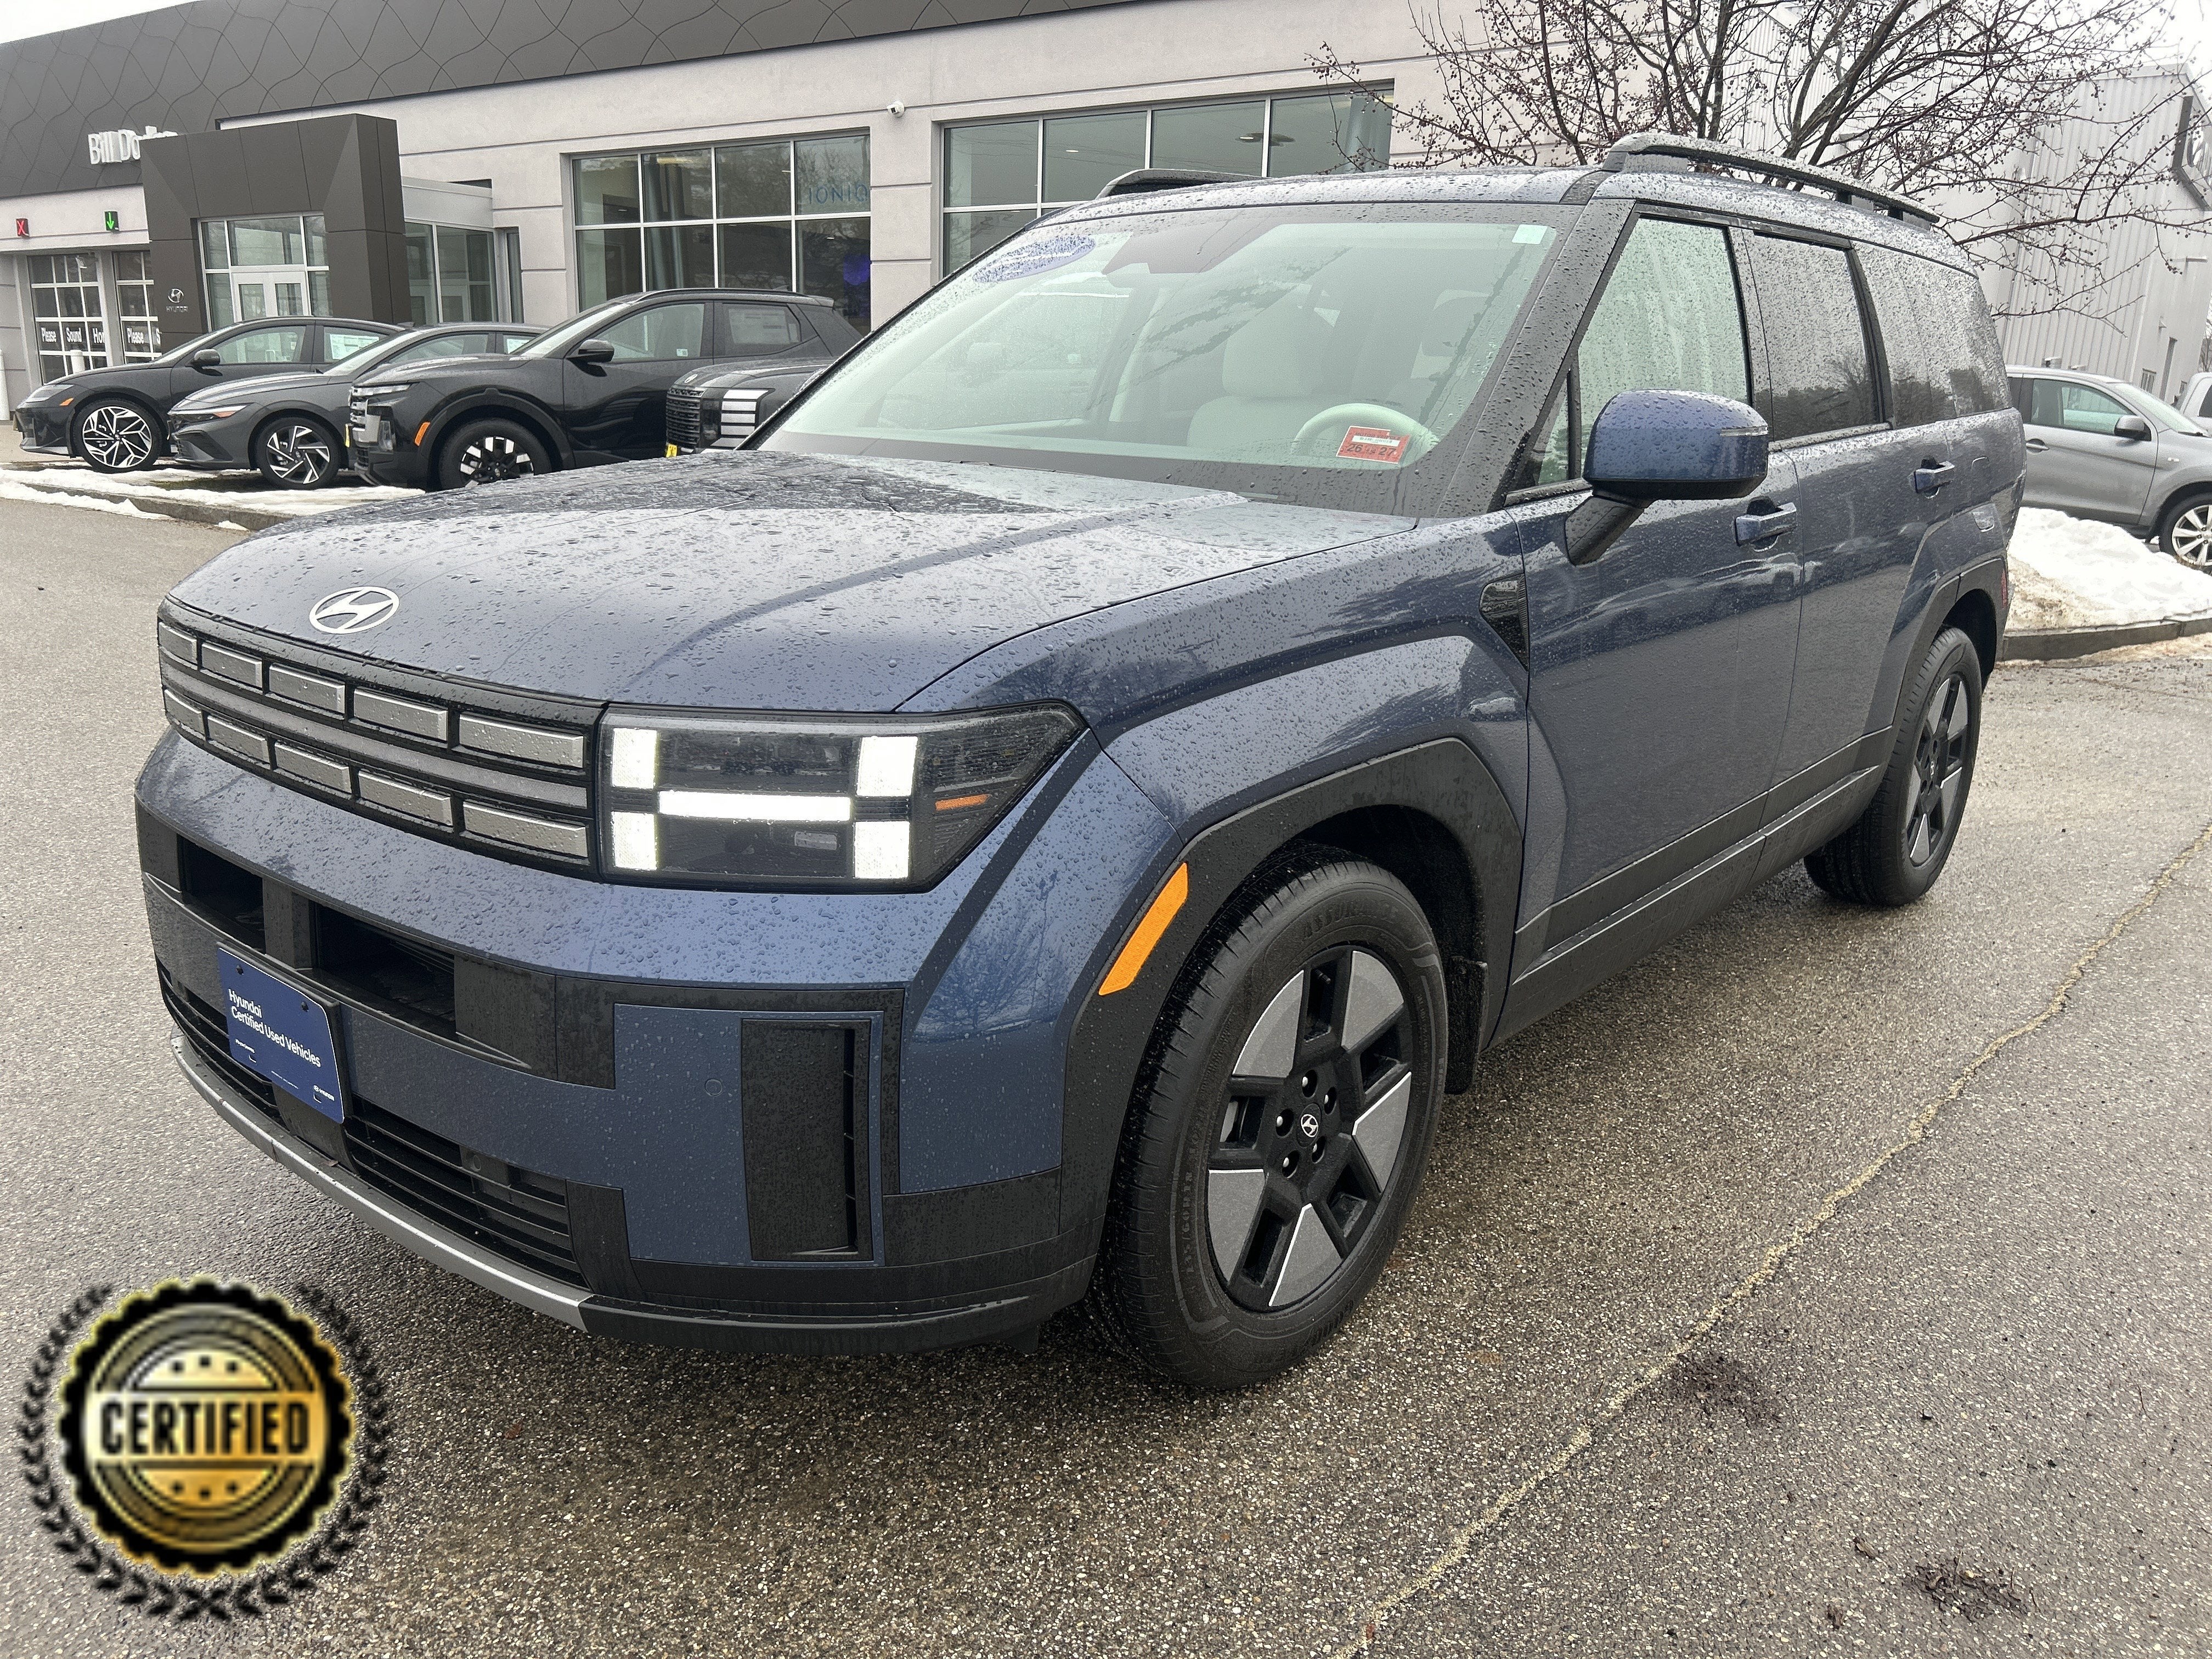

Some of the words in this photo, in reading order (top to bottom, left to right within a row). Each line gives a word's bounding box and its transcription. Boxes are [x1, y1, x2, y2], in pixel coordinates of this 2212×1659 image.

[88, 131, 120, 165] Bill
[41, 327, 57, 343] Please
[66, 327, 82, 343] Sound
[127, 328, 144, 344] Please
[1346, 443, 1363, 453] 26
[1378, 447, 1397, 456] 27
[228, 989, 262, 1018] Hyundai
[231, 1006, 264, 1035] Certified
[264, 1024, 285, 1047] Used
[284, 1036, 321, 1068] Vehicles
